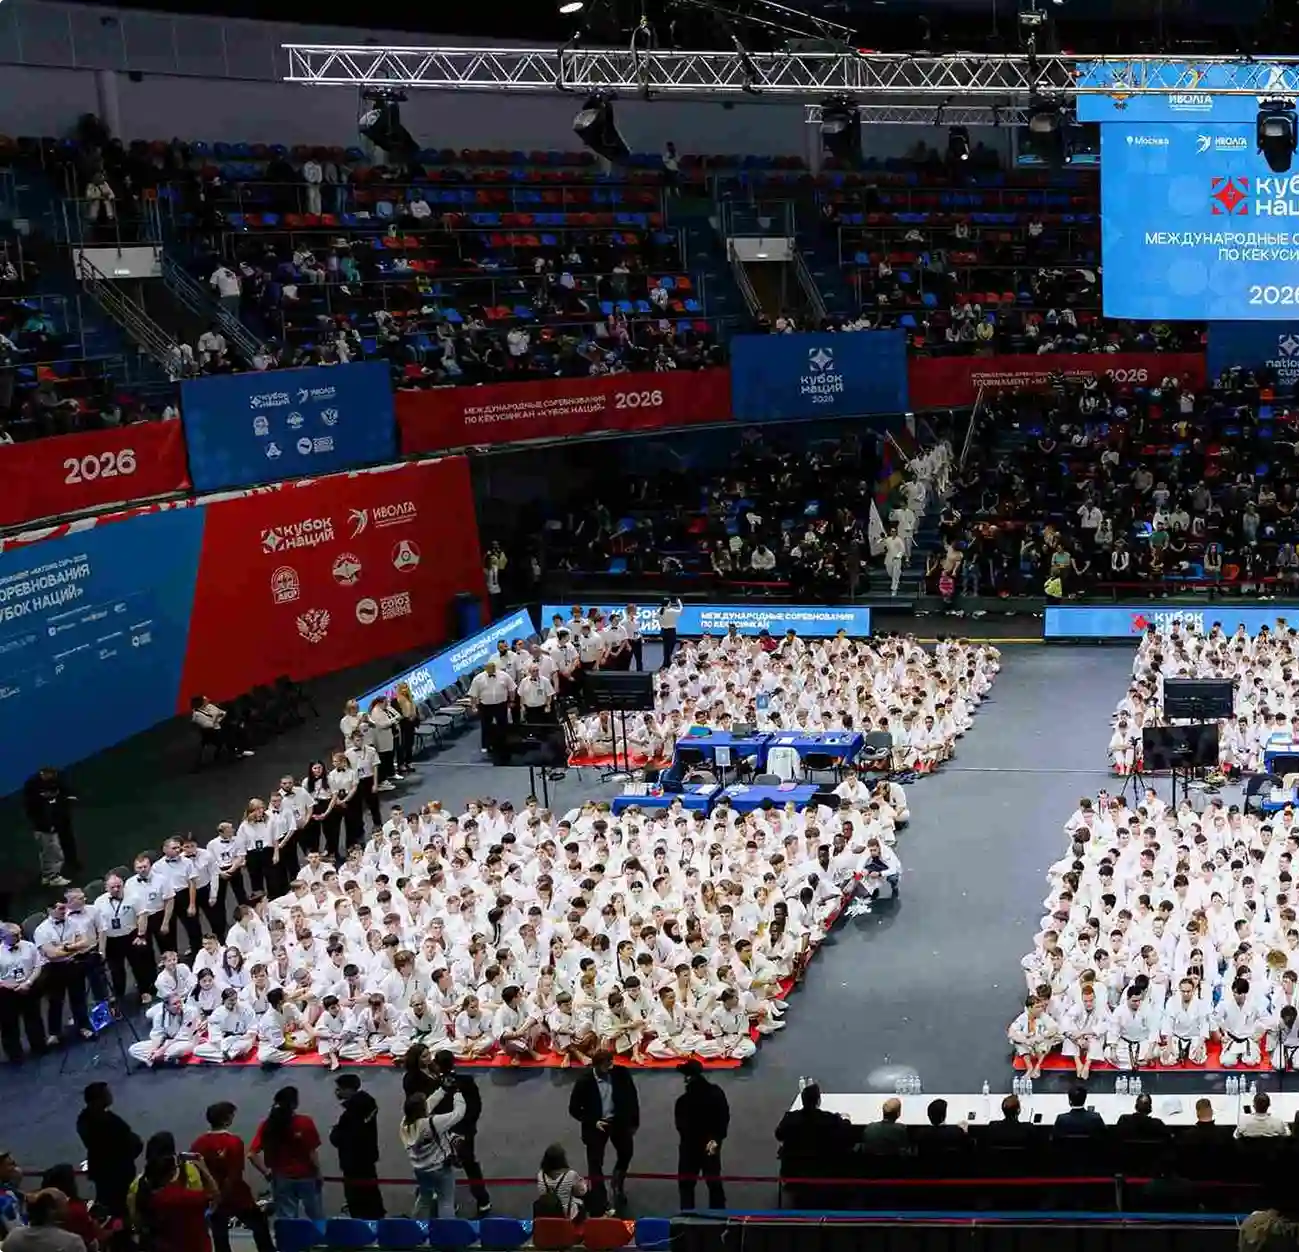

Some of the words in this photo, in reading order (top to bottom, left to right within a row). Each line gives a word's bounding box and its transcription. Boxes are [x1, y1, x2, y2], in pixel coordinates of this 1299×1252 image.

[1135, 137, 1169, 145] Москва
[1145, 232, 1288, 248] МЕЖДУНАРОДНЫЕ
[1218, 248, 1239, 261] ПО
[614, 390, 664, 409] 2026
[63, 449, 137, 485] 2026
[372, 501, 417, 520] ИВОЛГА
[283, 517, 332, 536] кубок
[285, 528, 335, 549] наций
[32, 583, 84, 611] НАЦИЙ»
[701, 611, 784, 621] МЕЖДУНАРОДНЫЕ
[785, 611, 855, 621] СОРЕВНОВАНИЯ
